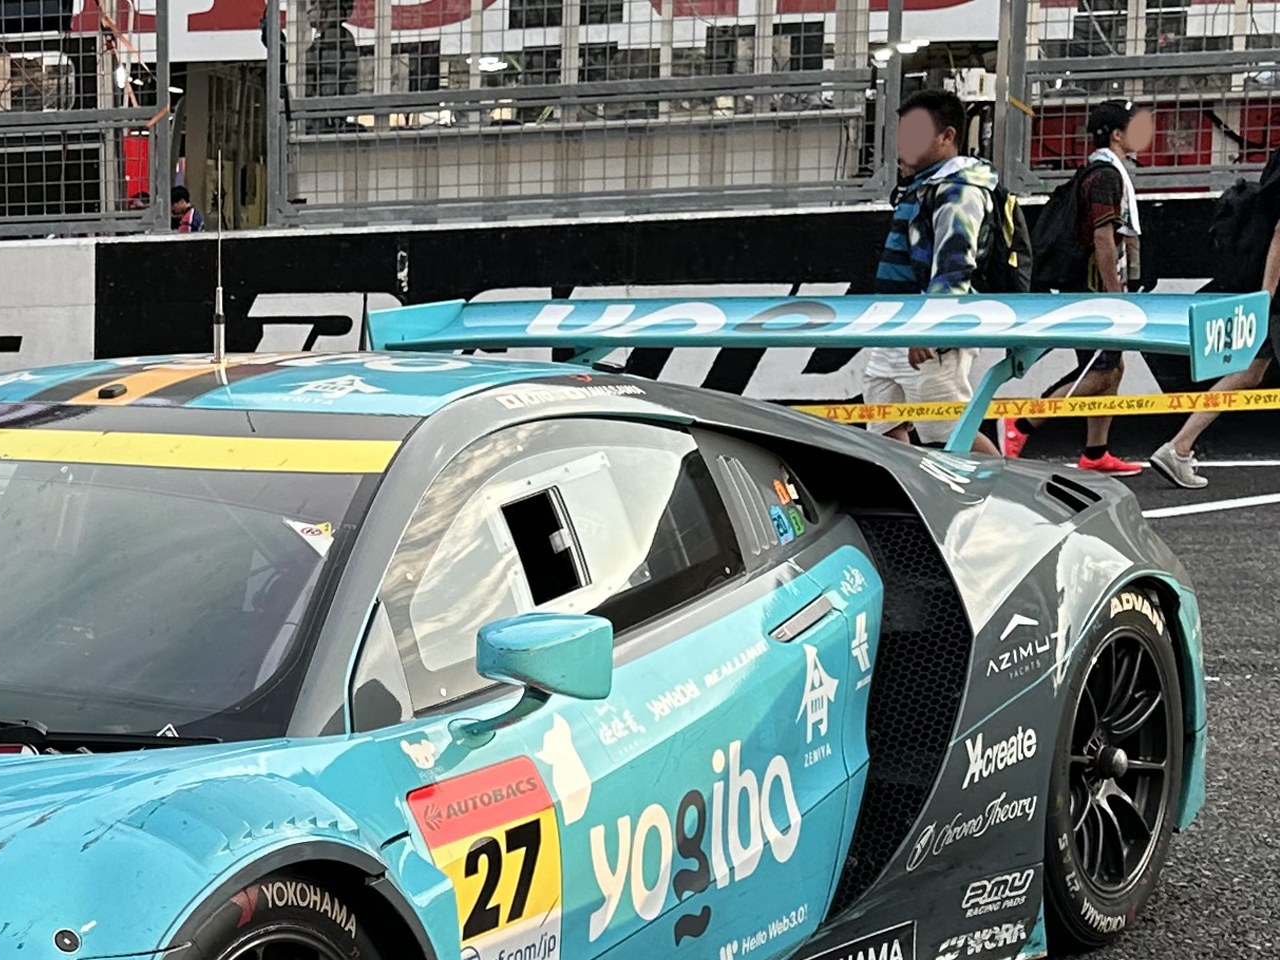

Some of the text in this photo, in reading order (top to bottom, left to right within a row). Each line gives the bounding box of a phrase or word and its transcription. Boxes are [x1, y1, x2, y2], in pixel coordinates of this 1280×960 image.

[1204, 304, 1257, 357] yogibo
[1110, 592, 1164, 637] ADVAN
[446, 776, 538, 820] AUTOBACS
[932, 791, 1038, 856] Chrono Theory
[589, 739, 802, 944] yogibo
[462, 817, 542, 941] 27
[261, 881, 358, 939] YOKOHAMA
[741, 903, 809, 956] Hello Web3.0!
[965, 895, 1027, 918] RACING PADS
